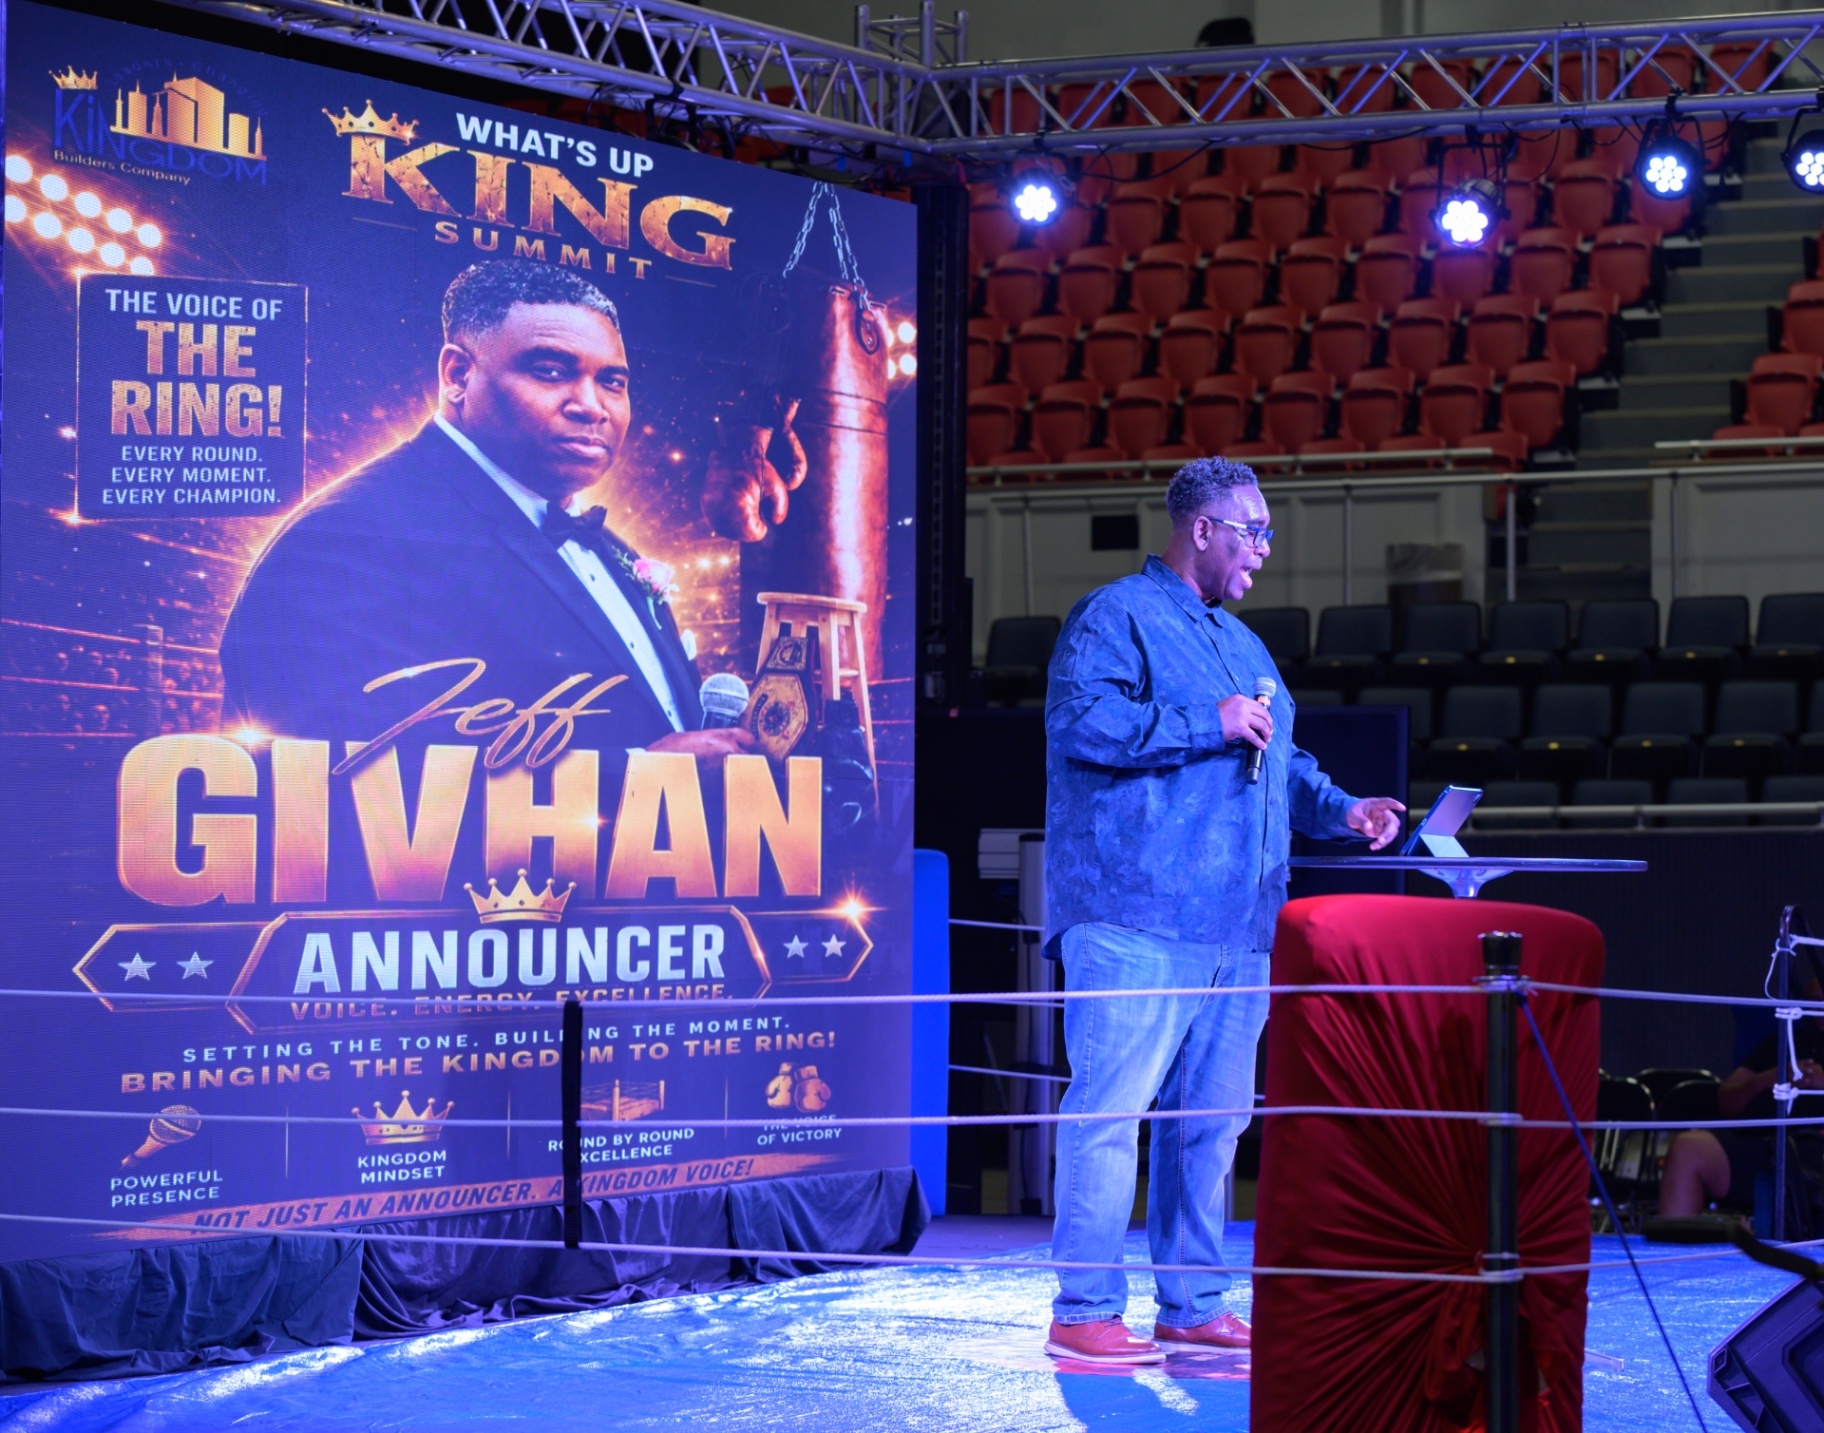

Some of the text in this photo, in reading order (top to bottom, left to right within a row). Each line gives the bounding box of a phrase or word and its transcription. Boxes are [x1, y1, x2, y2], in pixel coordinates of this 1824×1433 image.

[455, 112, 655, 178] WHAT'S UP
[53, 149, 191, 186] Builders Company
[341, 134, 737, 271] KING
[434, 220, 653, 280] SUMMIT
[105, 288, 283, 321] THE VOICE OF
[136, 320, 257, 378] THE
[111, 379, 283, 438] RING!
[121, 445, 263, 463] EVERY ROUND.
[111, 466, 272, 483] EVERY MOMENT.
[102, 487, 281, 505] EVERY CHAMPION.
[116, 733, 823, 907] GIVHAN
[293, 924, 726, 995] ANNOUNCER
[182, 1016, 791, 1063] SETTING THE TONE. BUILNG THE MOMENT.
[120, 1031, 837, 1093] BRINGING THE KINGDM TO THE RING!
[580, 1144, 673, 1164] XCELLENCE
[612, 1132, 634, 1147] BY
[639, 1127, 695, 1144] ROUND
[757, 1127, 842, 1146] OF VICTORY
[357, 1149, 448, 1169] KINGDOM
[361, 1165, 446, 1185] MINDSET
[110, 1169, 224, 1192] POWERFUL
[111, 1186, 220, 1208] PRESENCE
[190, 1210, 251, 1235] NOT
[257, 1201, 328, 1228] JUST
[333, 1197, 373, 1221] AN
[378, 1181, 537, 1216] ANNOUNCER.
[685, 1158, 755, 1183] VOICE!
